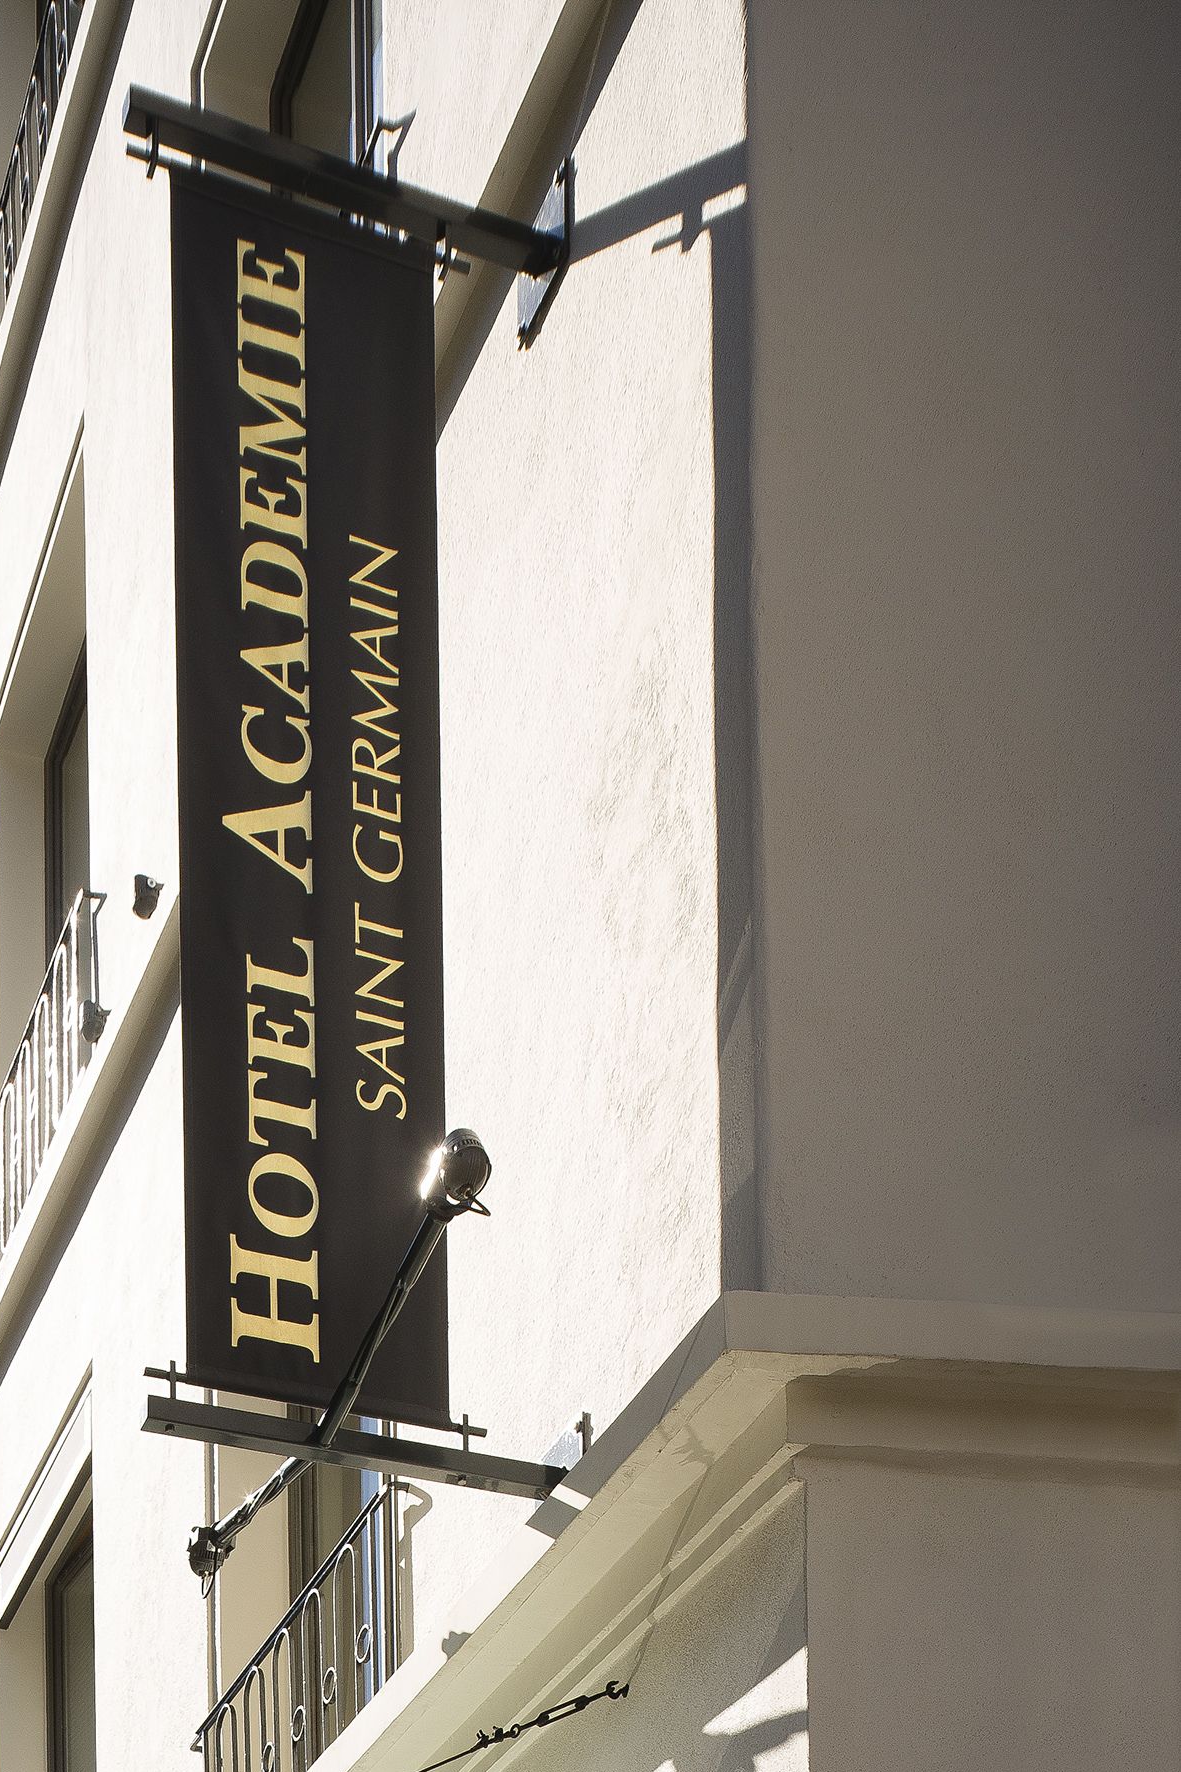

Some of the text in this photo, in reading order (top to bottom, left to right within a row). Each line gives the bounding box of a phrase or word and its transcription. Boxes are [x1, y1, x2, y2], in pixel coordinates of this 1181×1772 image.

[222, 238, 321, 1363] HOTEL ACADEMIE
[349, 534, 407, 1120] SAINT GERMAIN
